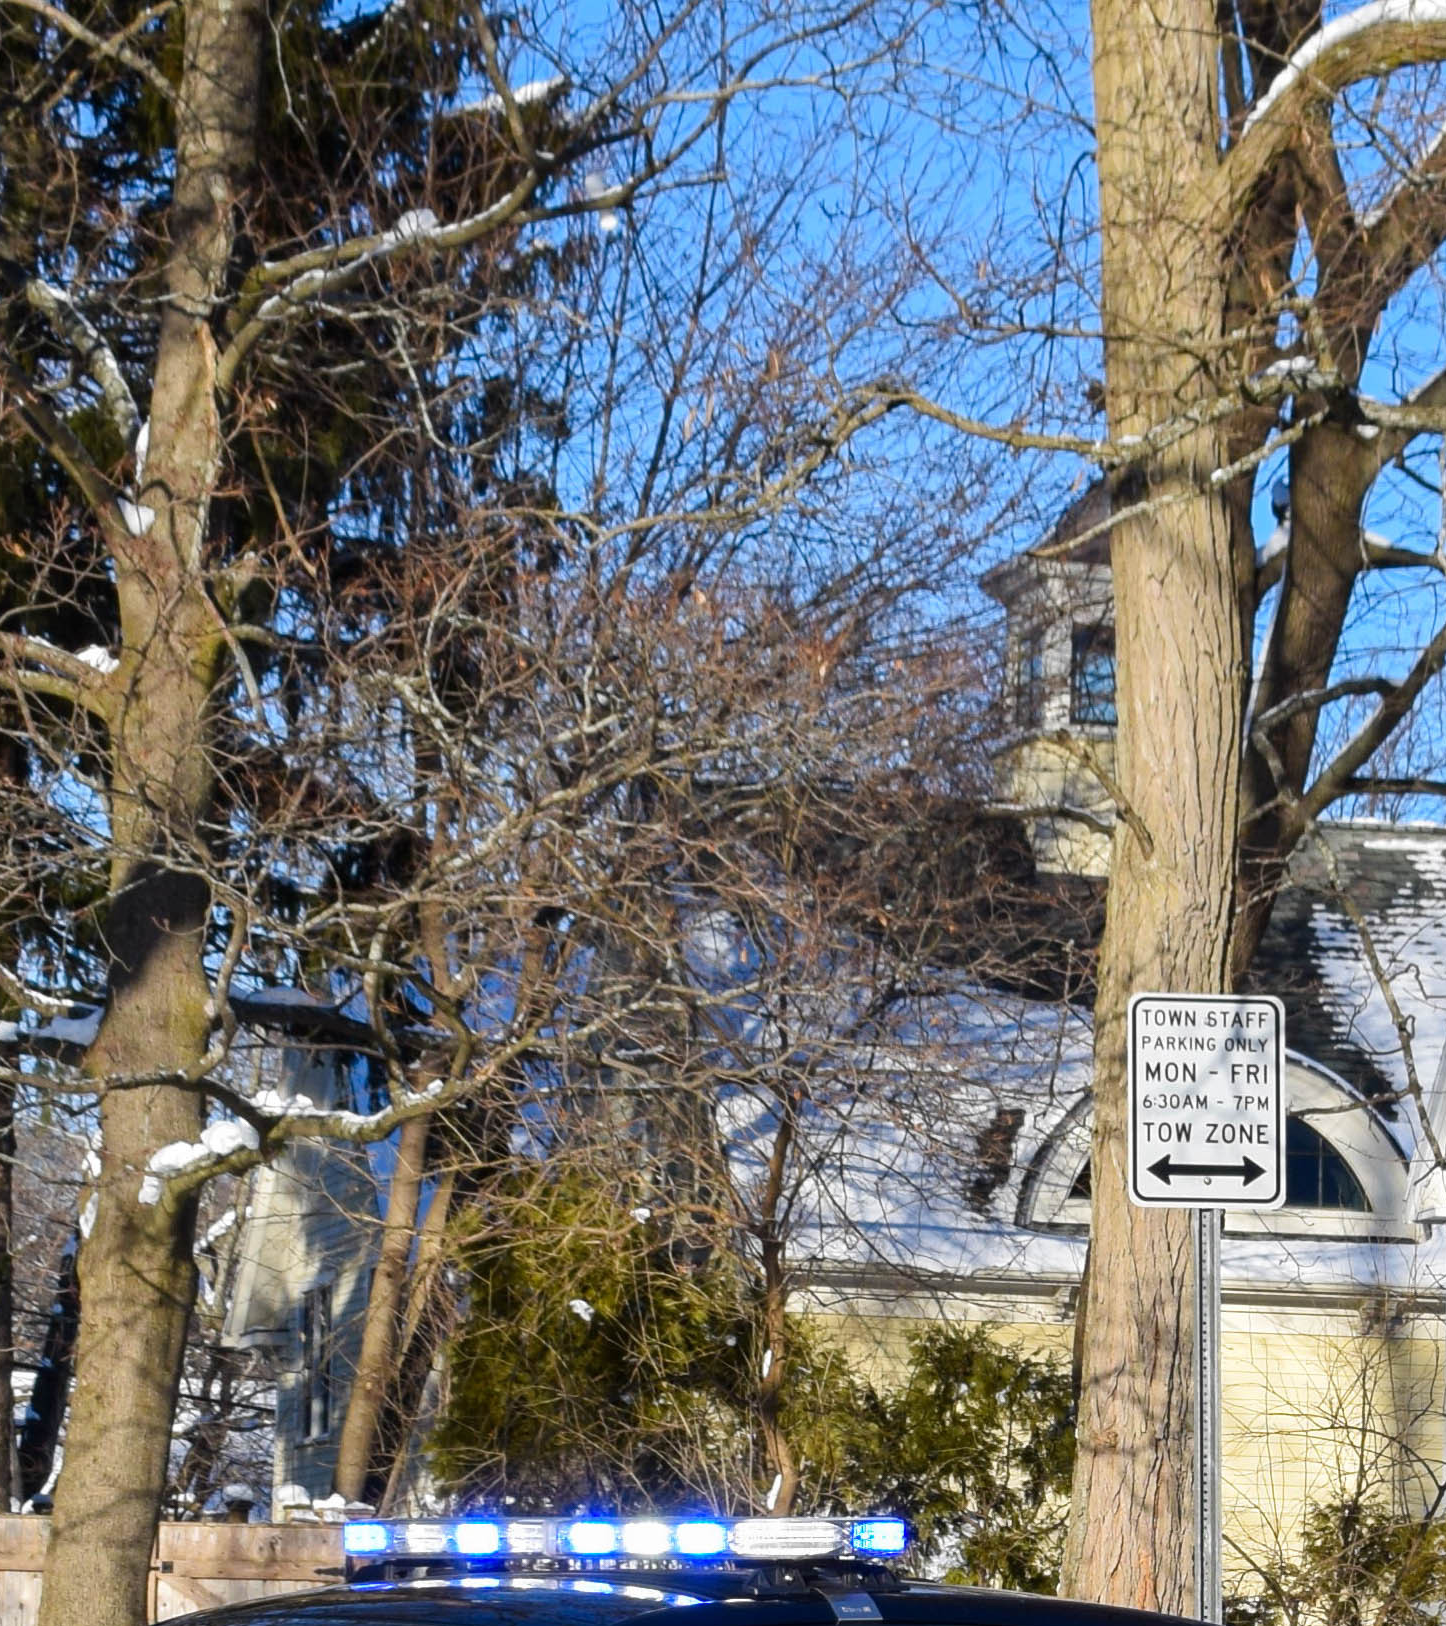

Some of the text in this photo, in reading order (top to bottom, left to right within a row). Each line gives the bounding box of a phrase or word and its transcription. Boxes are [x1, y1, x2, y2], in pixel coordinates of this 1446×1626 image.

[1142, 1009, 1269, 1028] TOWN STAFF
[1142, 1037, 1269, 1052] PARKING ONLY
[1145, 1062, 1196, 1082] MON
[1231, 1064, 1268, 1084] FRI
[1143, 1094, 1208, 1109] 6:30AM
[1234, 1096, 1269, 1111] 7PM
[1143, 1122, 1269, 1144] TOW ZONE
